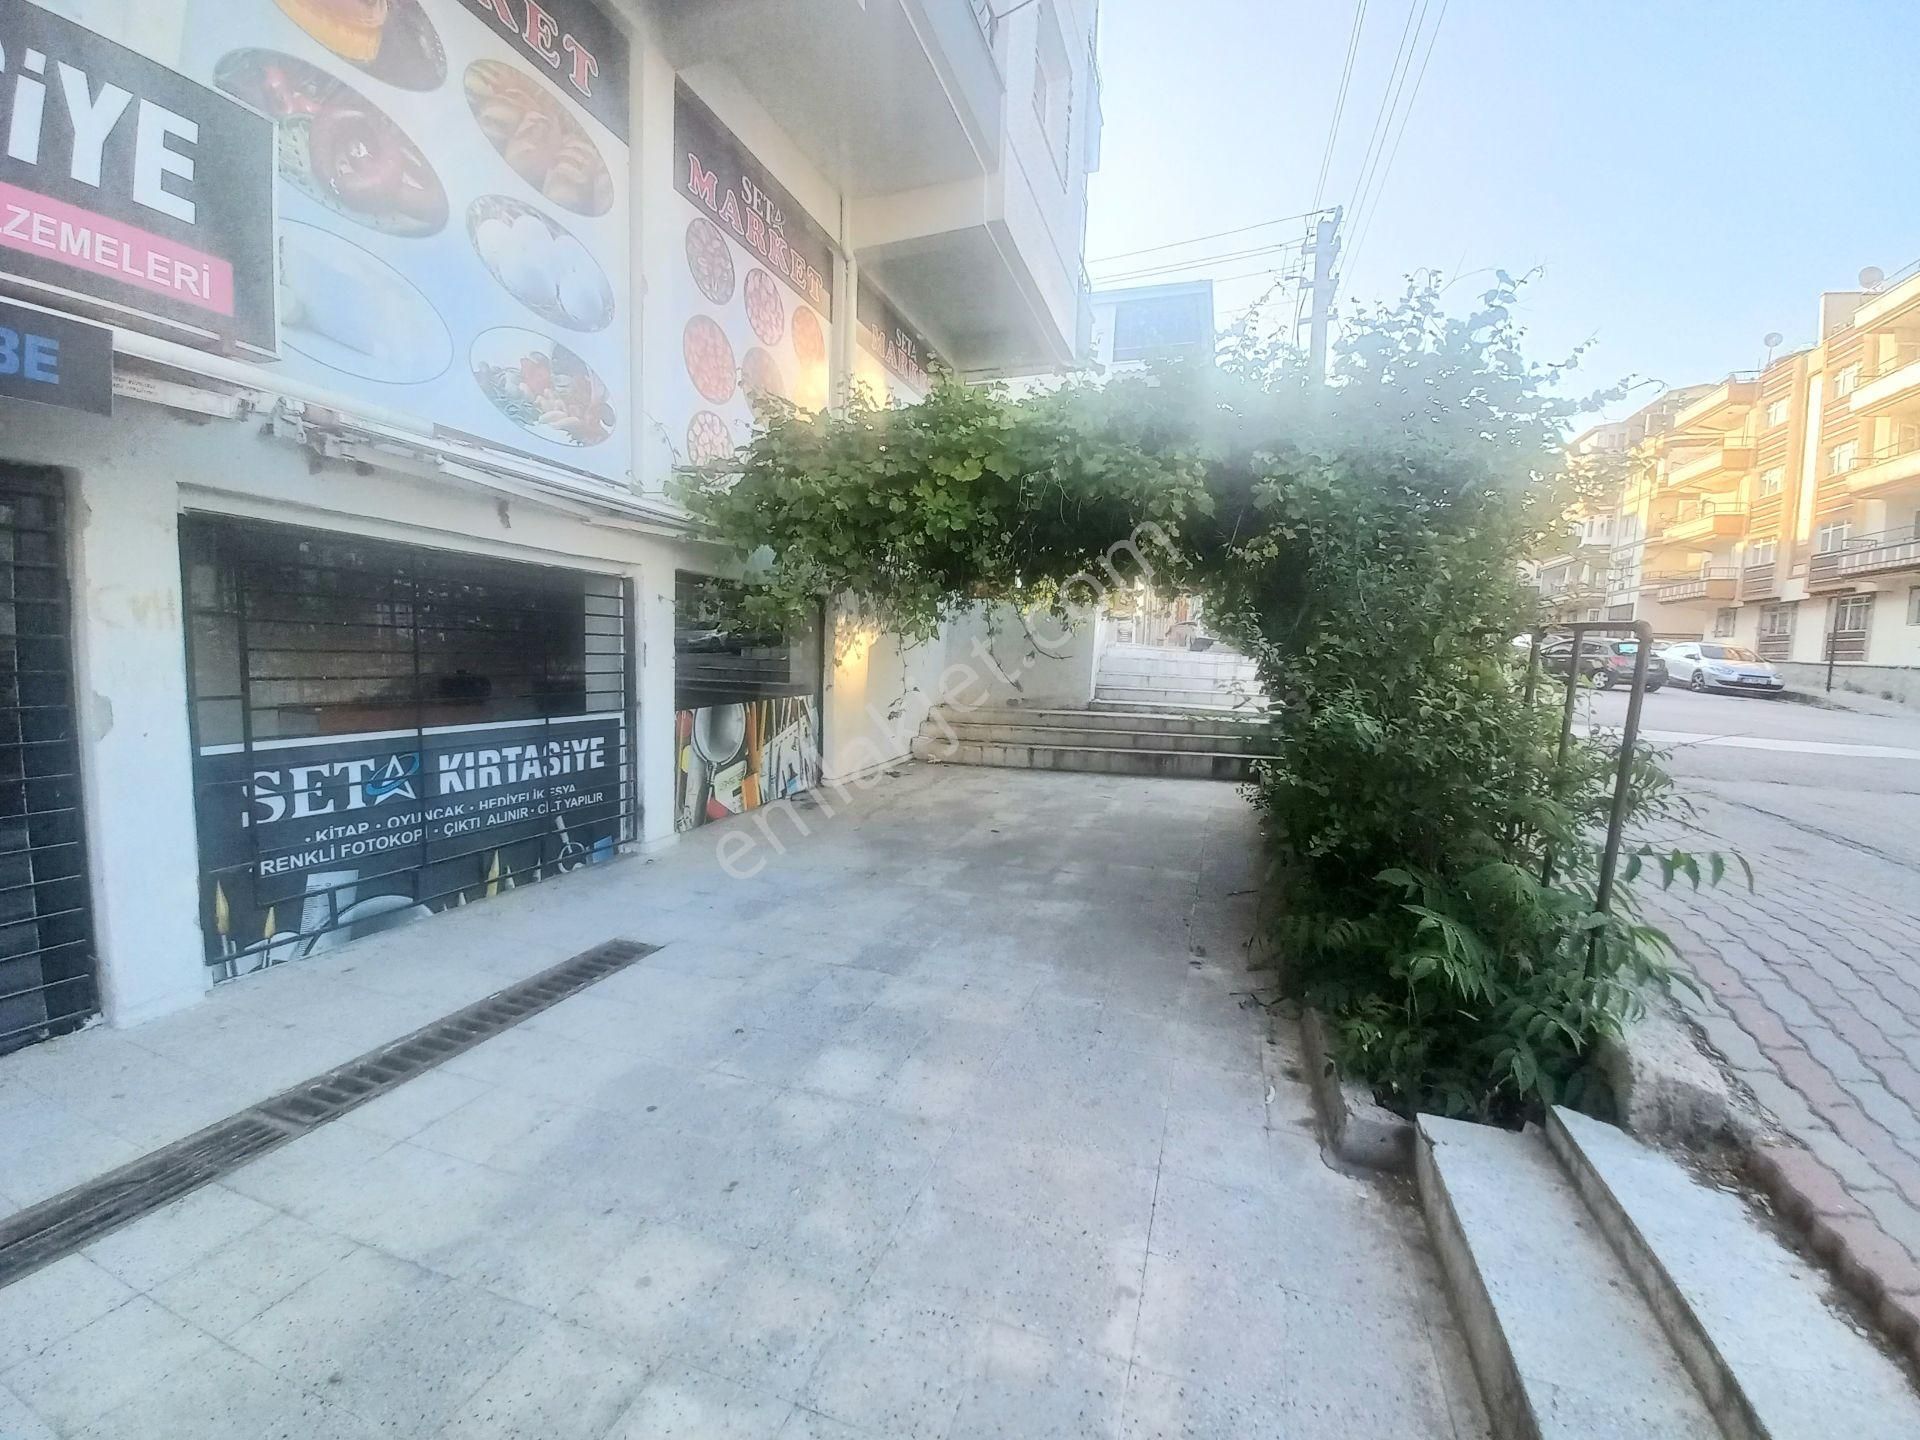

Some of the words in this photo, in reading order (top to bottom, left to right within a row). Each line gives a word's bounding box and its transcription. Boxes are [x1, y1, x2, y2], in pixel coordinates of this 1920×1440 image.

[0, 203, 210, 299] ZEMELERİ
[688, 152, 823, 303] MARKET
[260, 844, 335, 876] RENKLİ
[443, 816, 481, 838] ÇIKTI
[486, 807, 529, 826] ALINIR
[564, 792, 603, 809] YAPILIR
[315, 822, 370, 842] KİTAP
[387, 804, 465, 829] OYUNCAK
